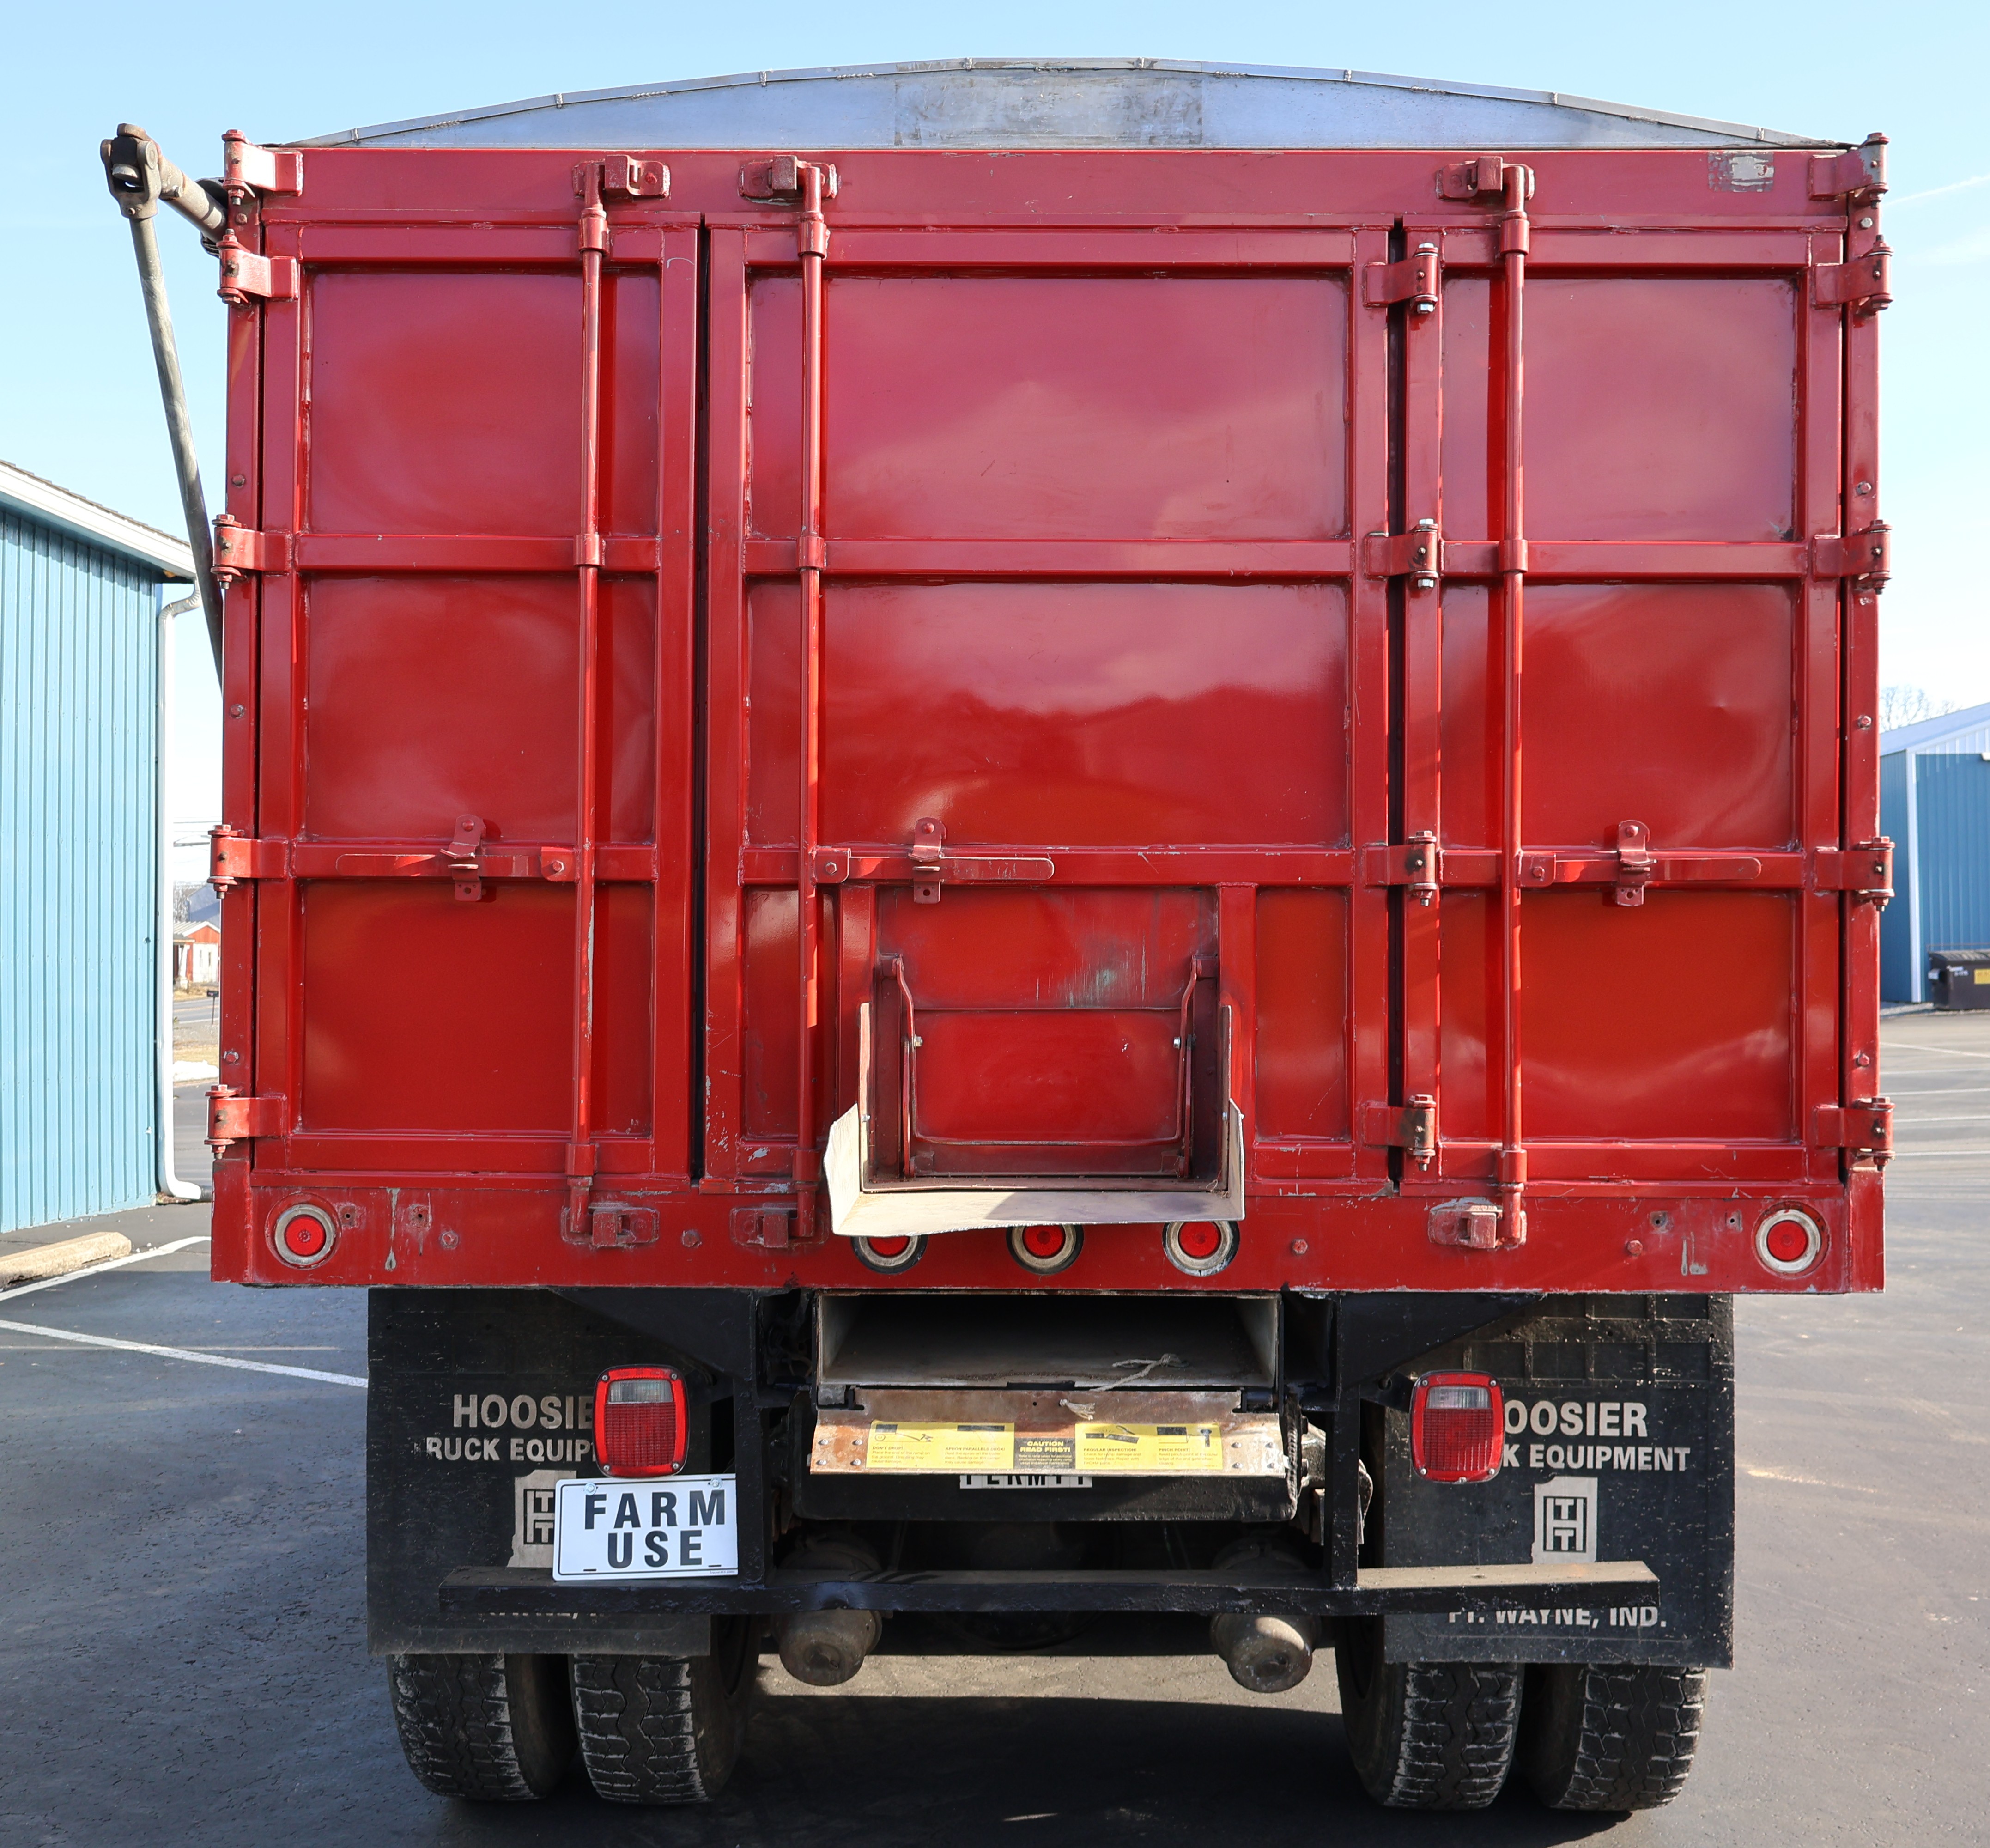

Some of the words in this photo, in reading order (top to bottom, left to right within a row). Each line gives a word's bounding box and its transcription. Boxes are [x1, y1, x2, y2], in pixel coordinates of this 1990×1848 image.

[453, 1394, 595, 1429] HOOSIE
[1504, 1400, 1648, 1437] OOSIER
[426, 1437, 500, 1461] RUCK
[510, 1438, 596, 1462] EQUIP
[1530, 1444, 1691, 1471] EQUIPMENT
[584, 1489, 725, 1530] FARM
[608, 1530, 702, 1568] USE
[1609, 1606, 1667, 1627] IND.
